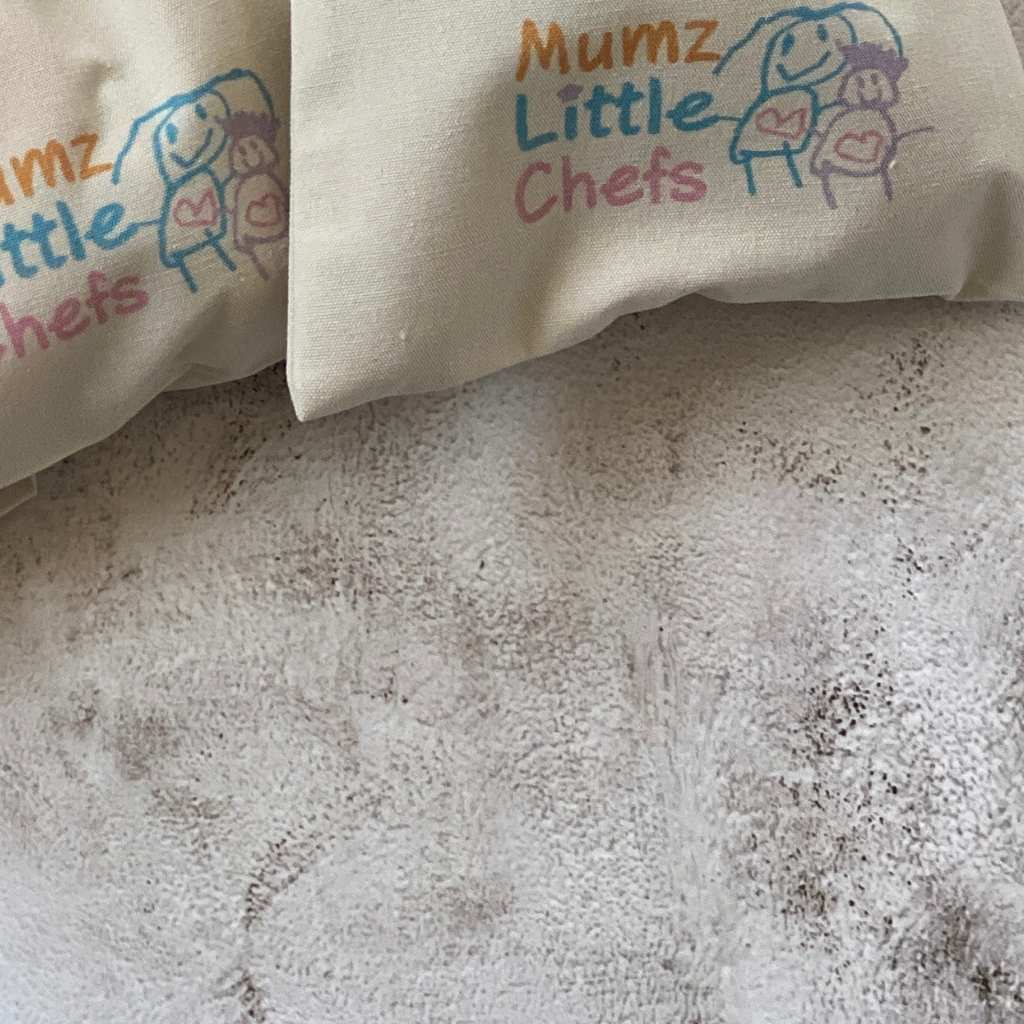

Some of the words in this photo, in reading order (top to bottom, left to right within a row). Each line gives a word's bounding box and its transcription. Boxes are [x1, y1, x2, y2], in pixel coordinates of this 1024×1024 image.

[516, 18, 721, 81] Mumz
[516, 76, 721, 152] Little
[515, 146, 708, 224] Chefs
